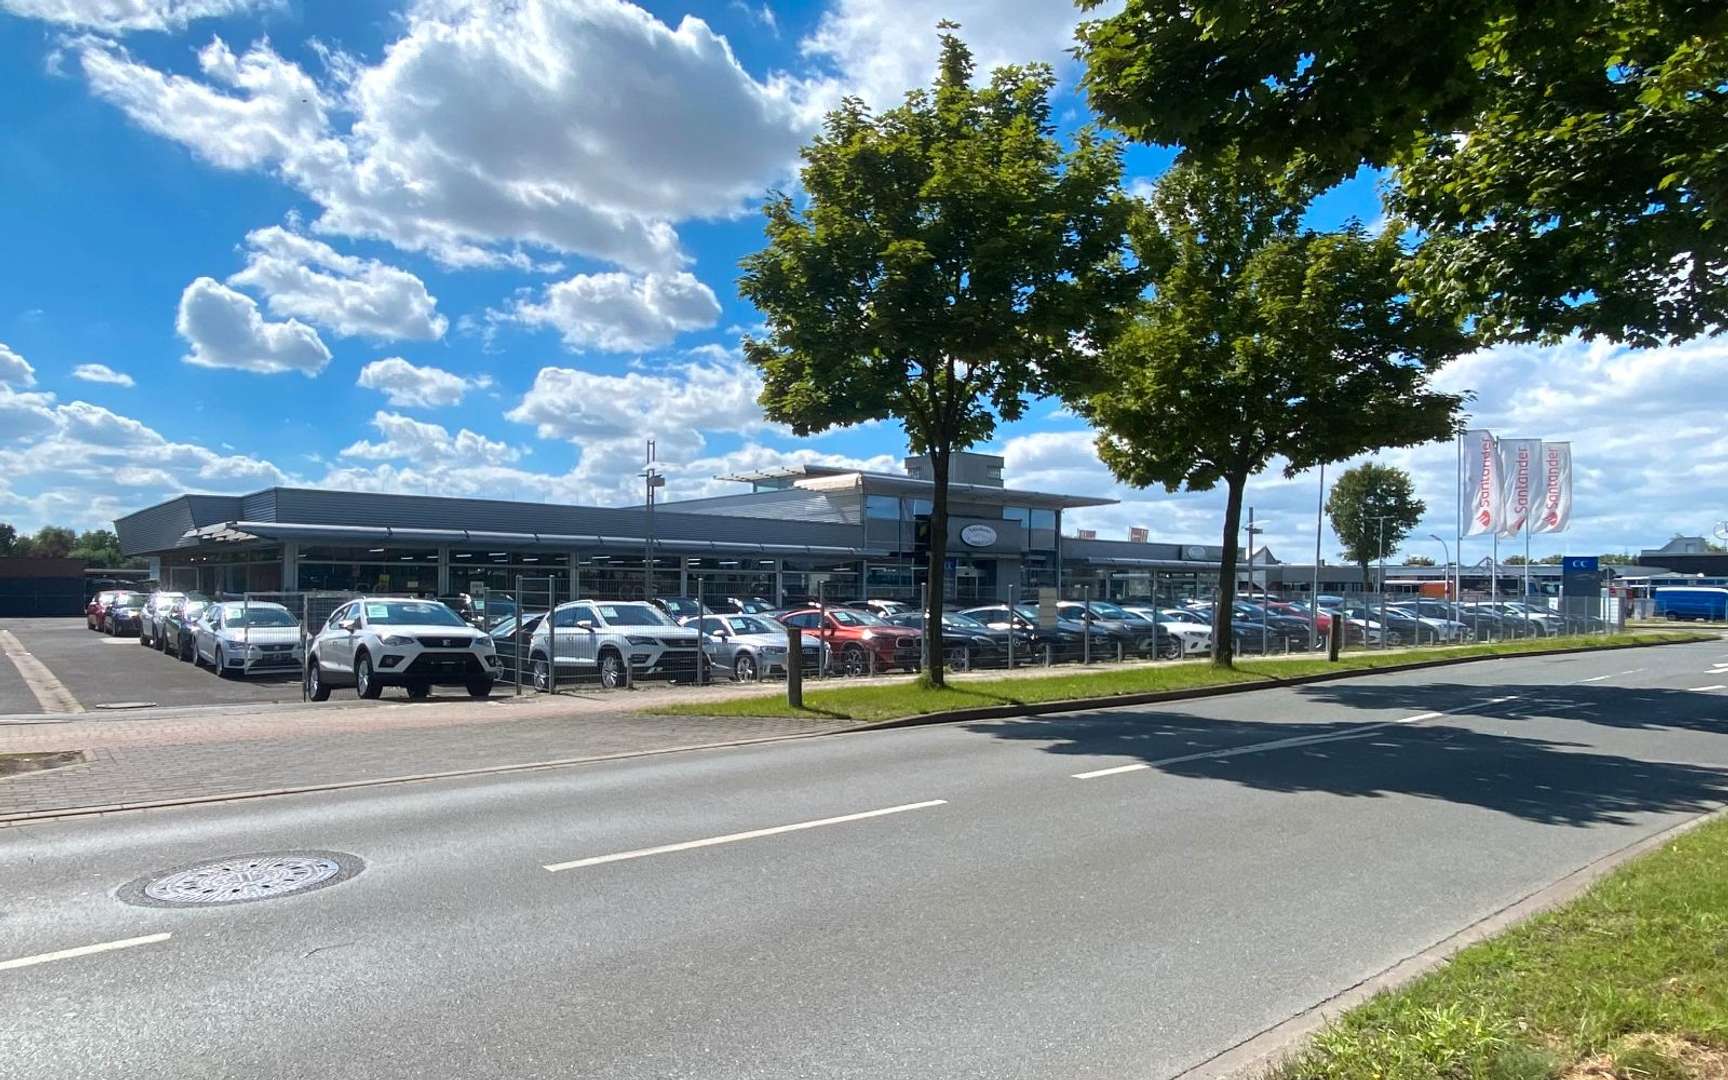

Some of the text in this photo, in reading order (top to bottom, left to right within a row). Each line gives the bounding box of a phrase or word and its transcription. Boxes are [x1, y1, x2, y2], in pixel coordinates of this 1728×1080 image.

[1480, 437, 1493, 508] Santander
[1514, 447, 1529, 514] Santander
[1545, 447, 1561, 510] Santander
